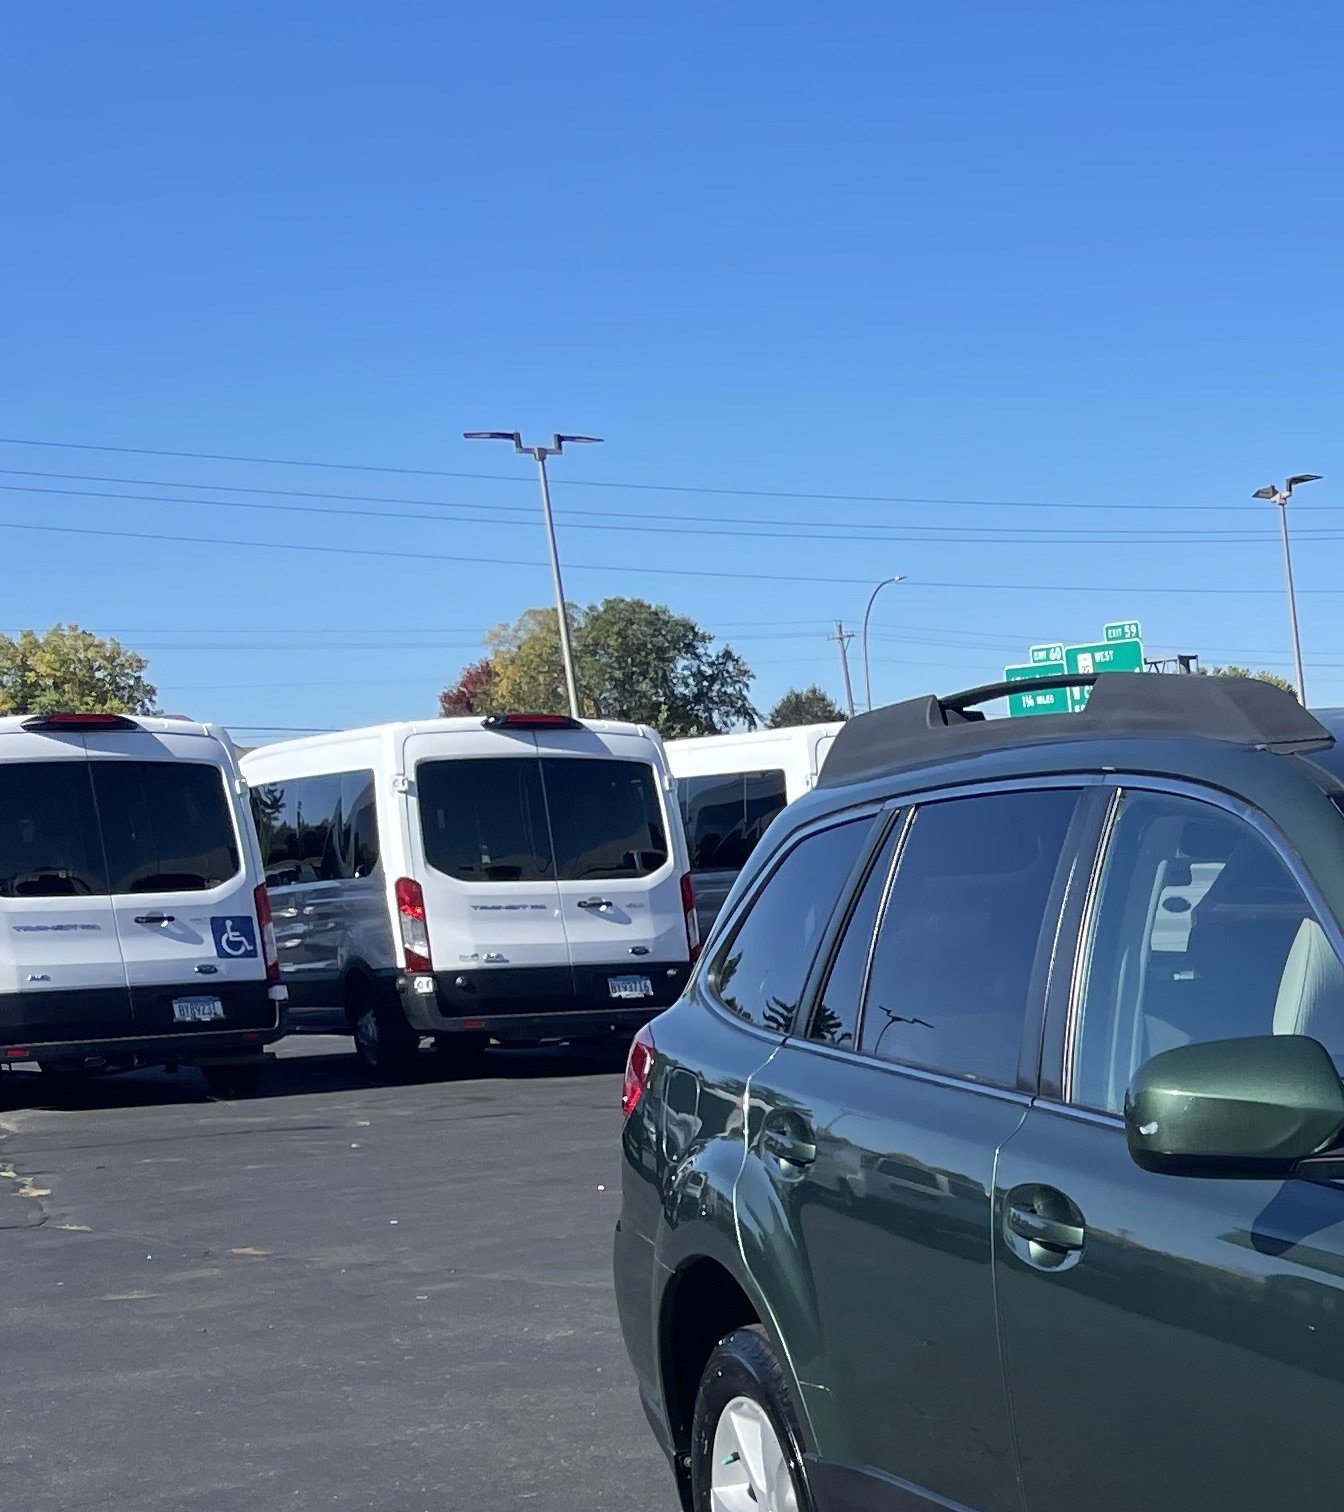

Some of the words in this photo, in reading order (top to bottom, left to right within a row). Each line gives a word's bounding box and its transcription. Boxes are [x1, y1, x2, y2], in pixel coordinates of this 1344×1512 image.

[1107, 627, 1122, 638] EXIT
[1124, 624, 1137, 638] 59
[1049, 647, 1062, 661] 60
[1094, 650, 1114, 662] WEST
